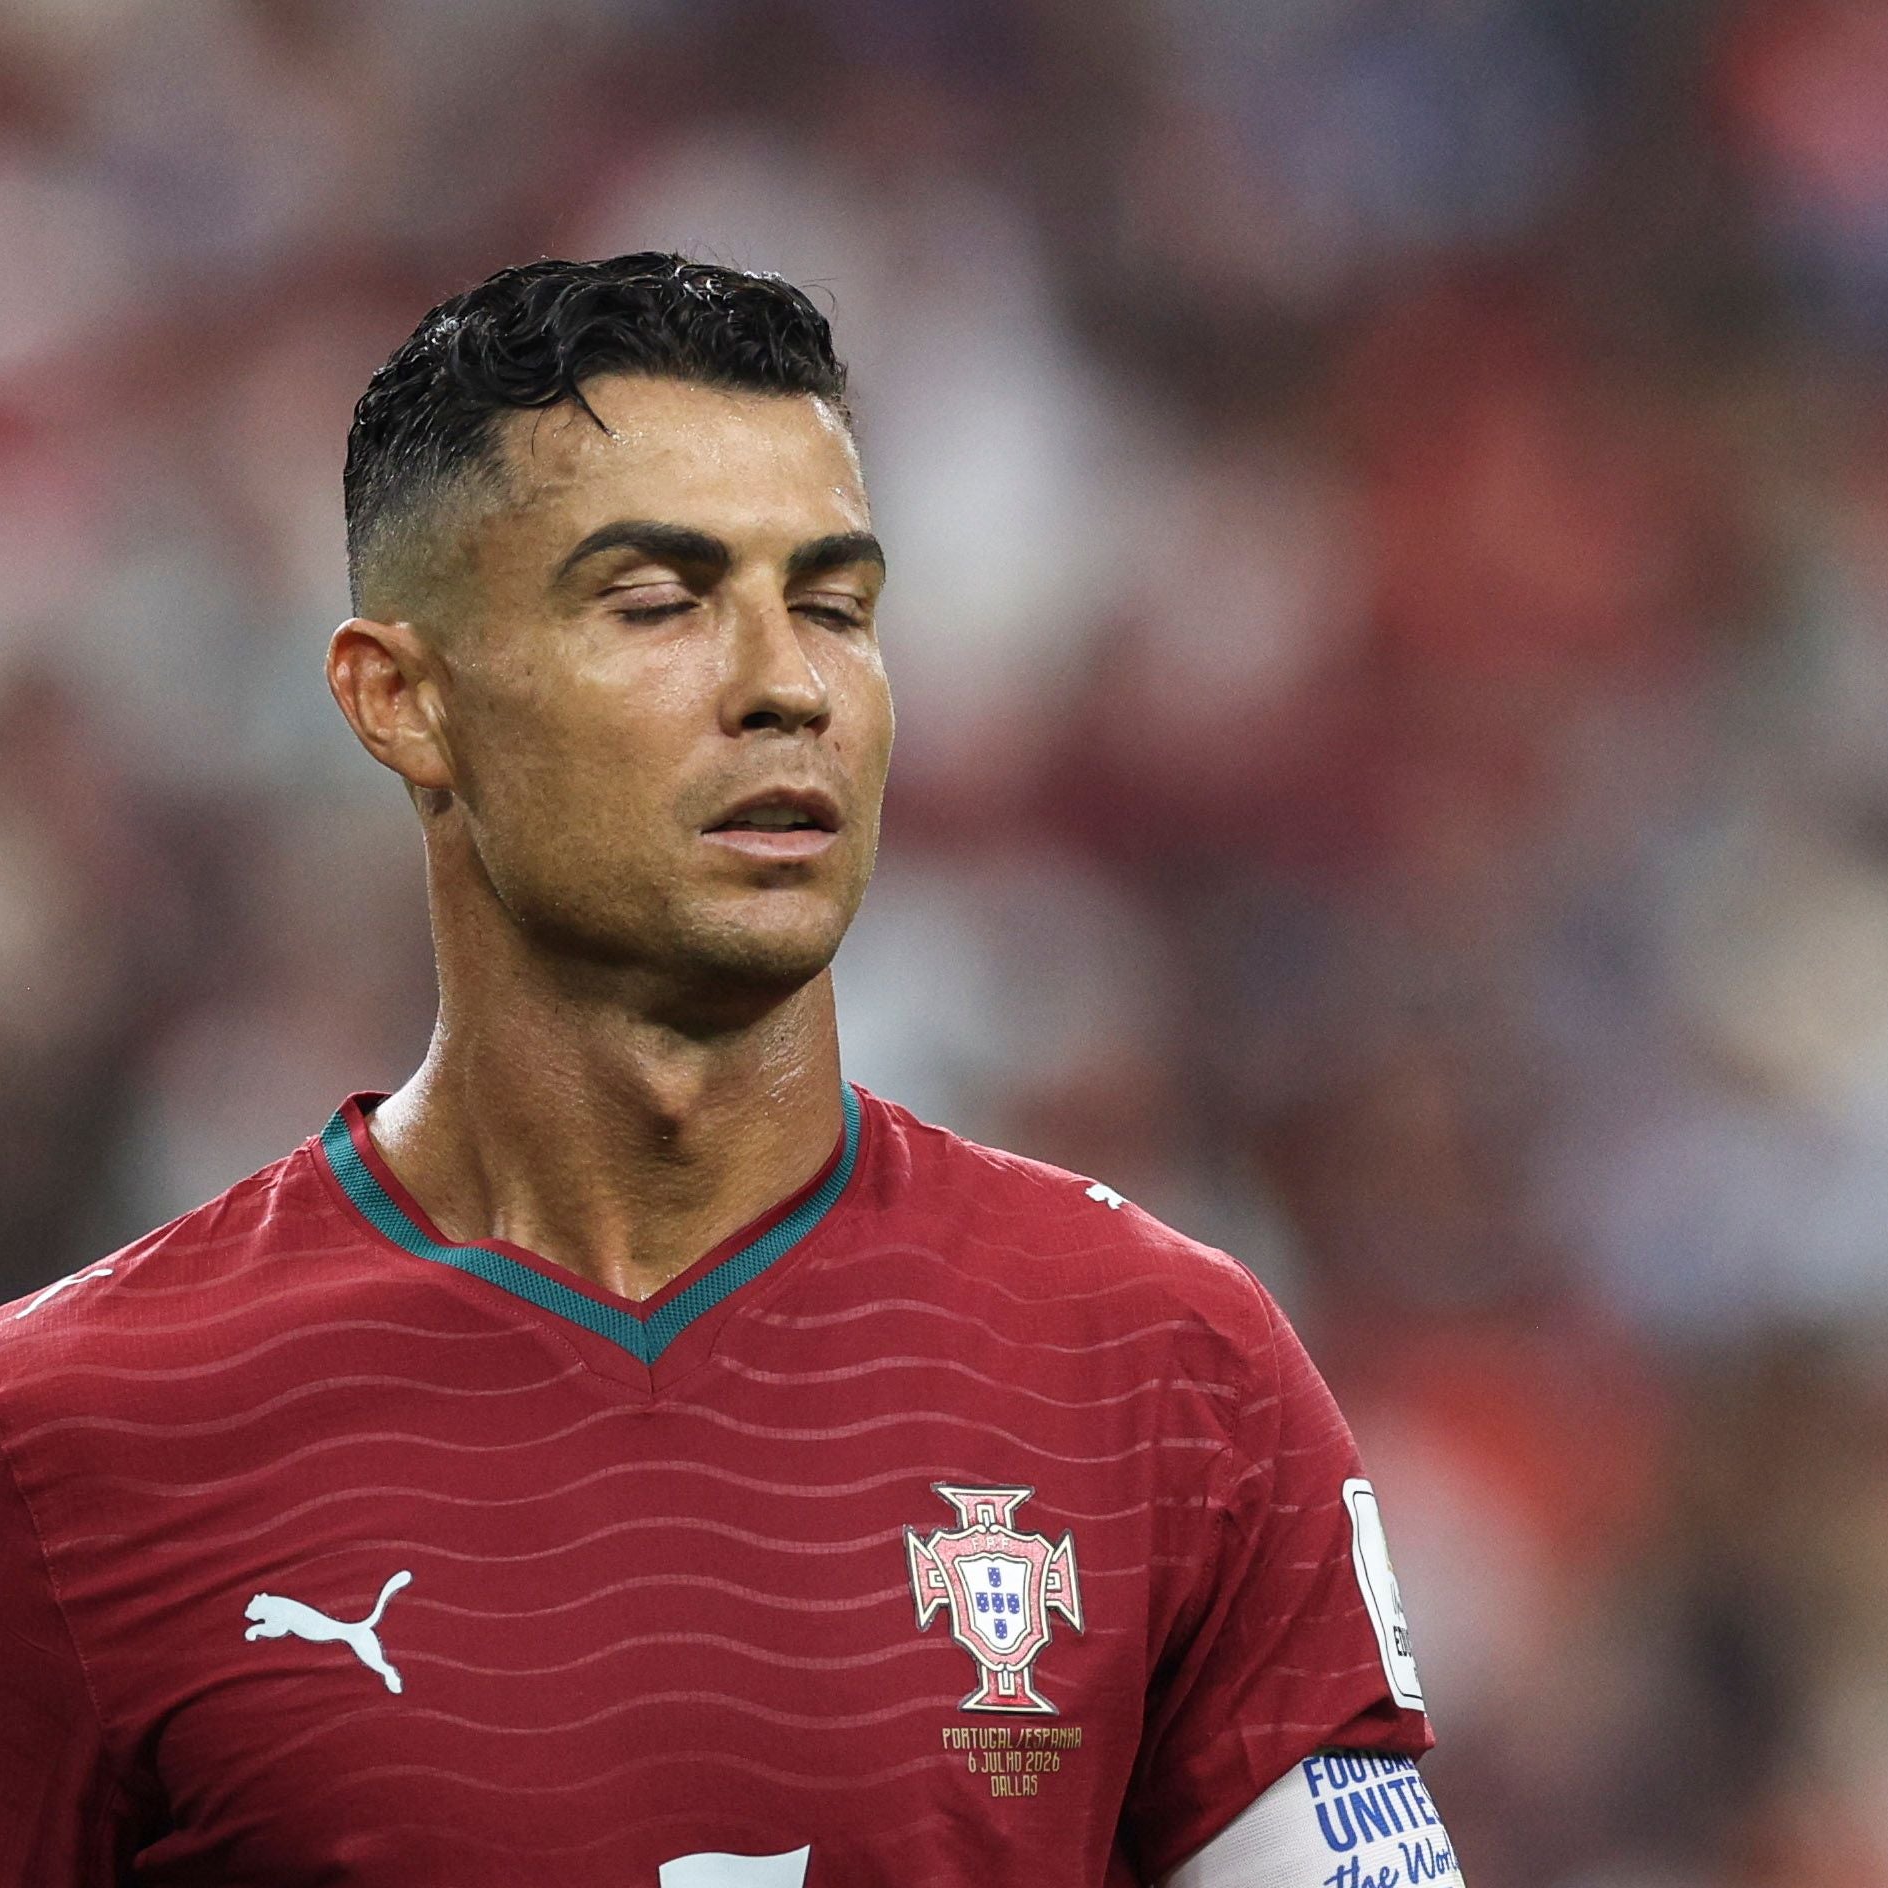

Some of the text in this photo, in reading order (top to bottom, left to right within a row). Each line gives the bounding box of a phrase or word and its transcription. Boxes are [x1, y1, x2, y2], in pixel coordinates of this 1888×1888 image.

[942, 1727, 1012, 1749] PORTUGAL
[968, 1752, 1060, 1773] 6 JULHO 2026
[991, 1775, 1038, 1797] DALLAS
[1315, 1776, 1439, 1852] UNITE
